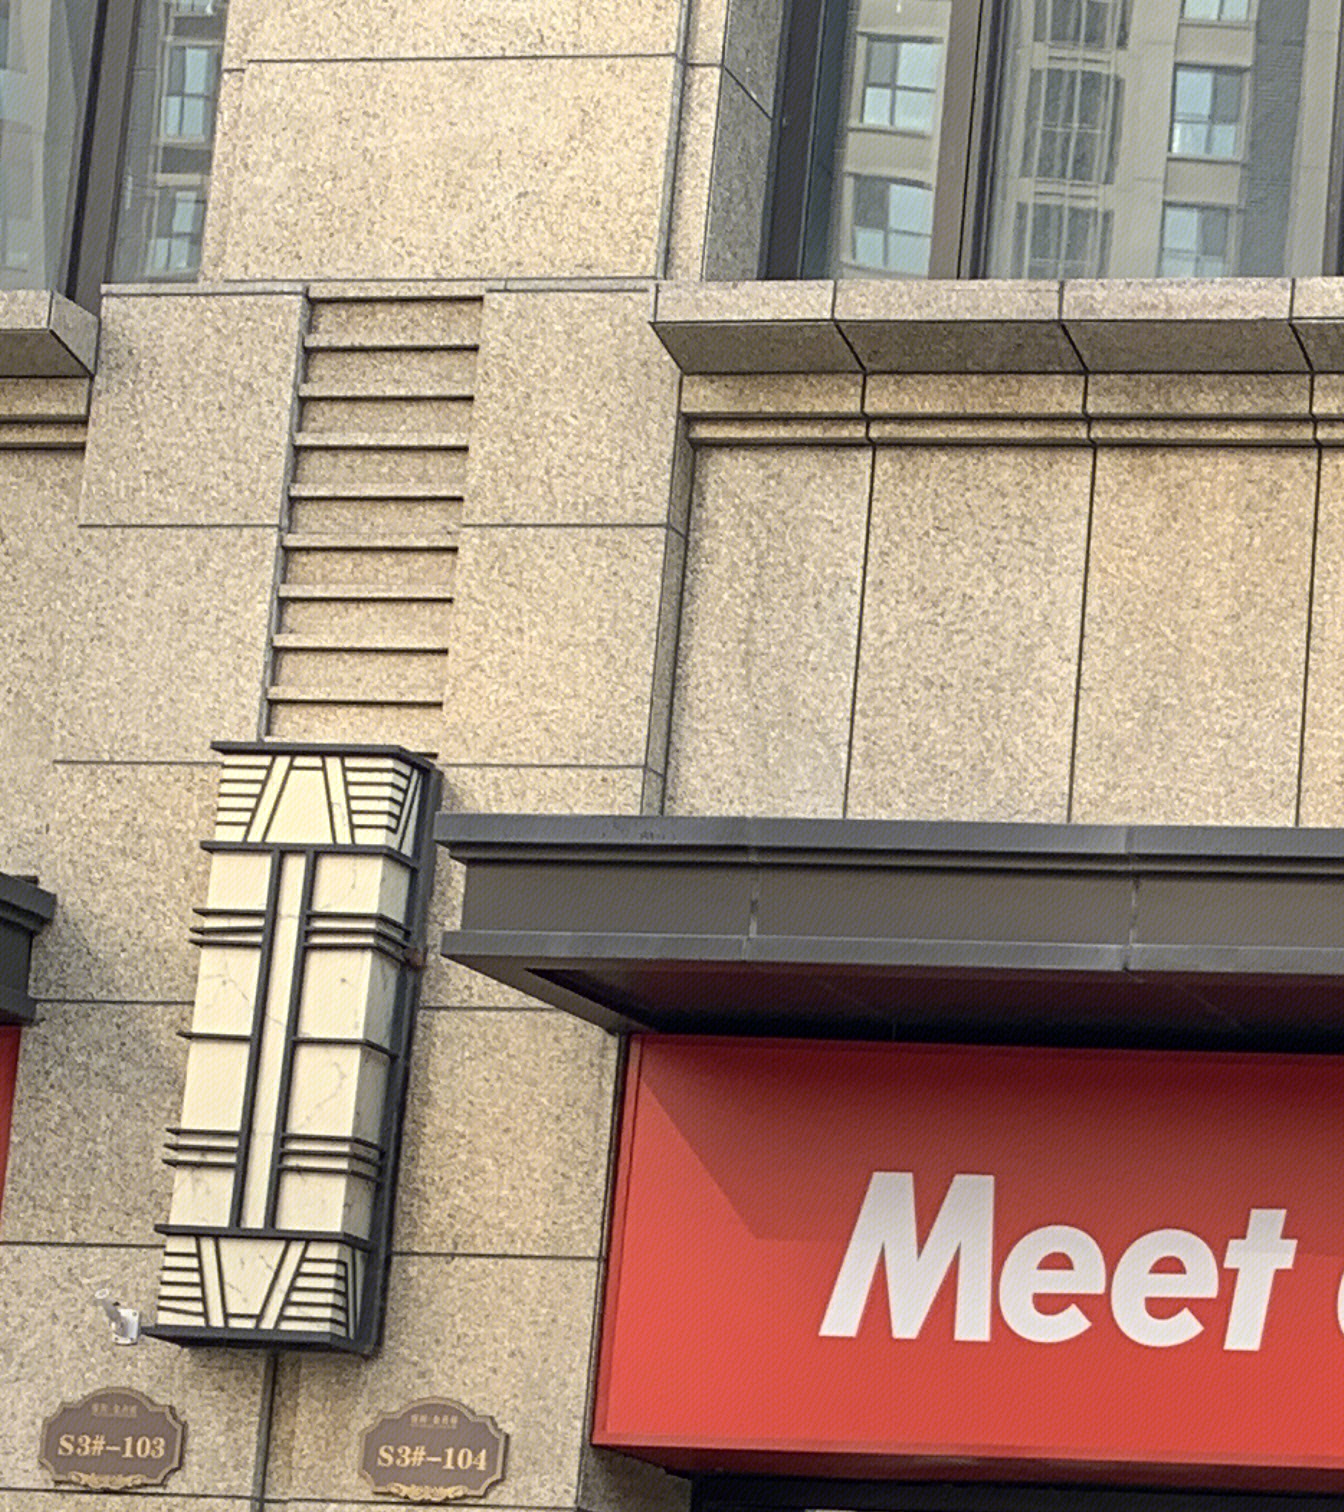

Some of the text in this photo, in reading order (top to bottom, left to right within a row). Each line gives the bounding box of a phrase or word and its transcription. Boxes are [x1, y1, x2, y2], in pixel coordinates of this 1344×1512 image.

[818, 1170, 1299, 1351] Meet
[57, 1433, 166, 1459] S3#-103
[376, 1444, 488, 1472] S3#-104
